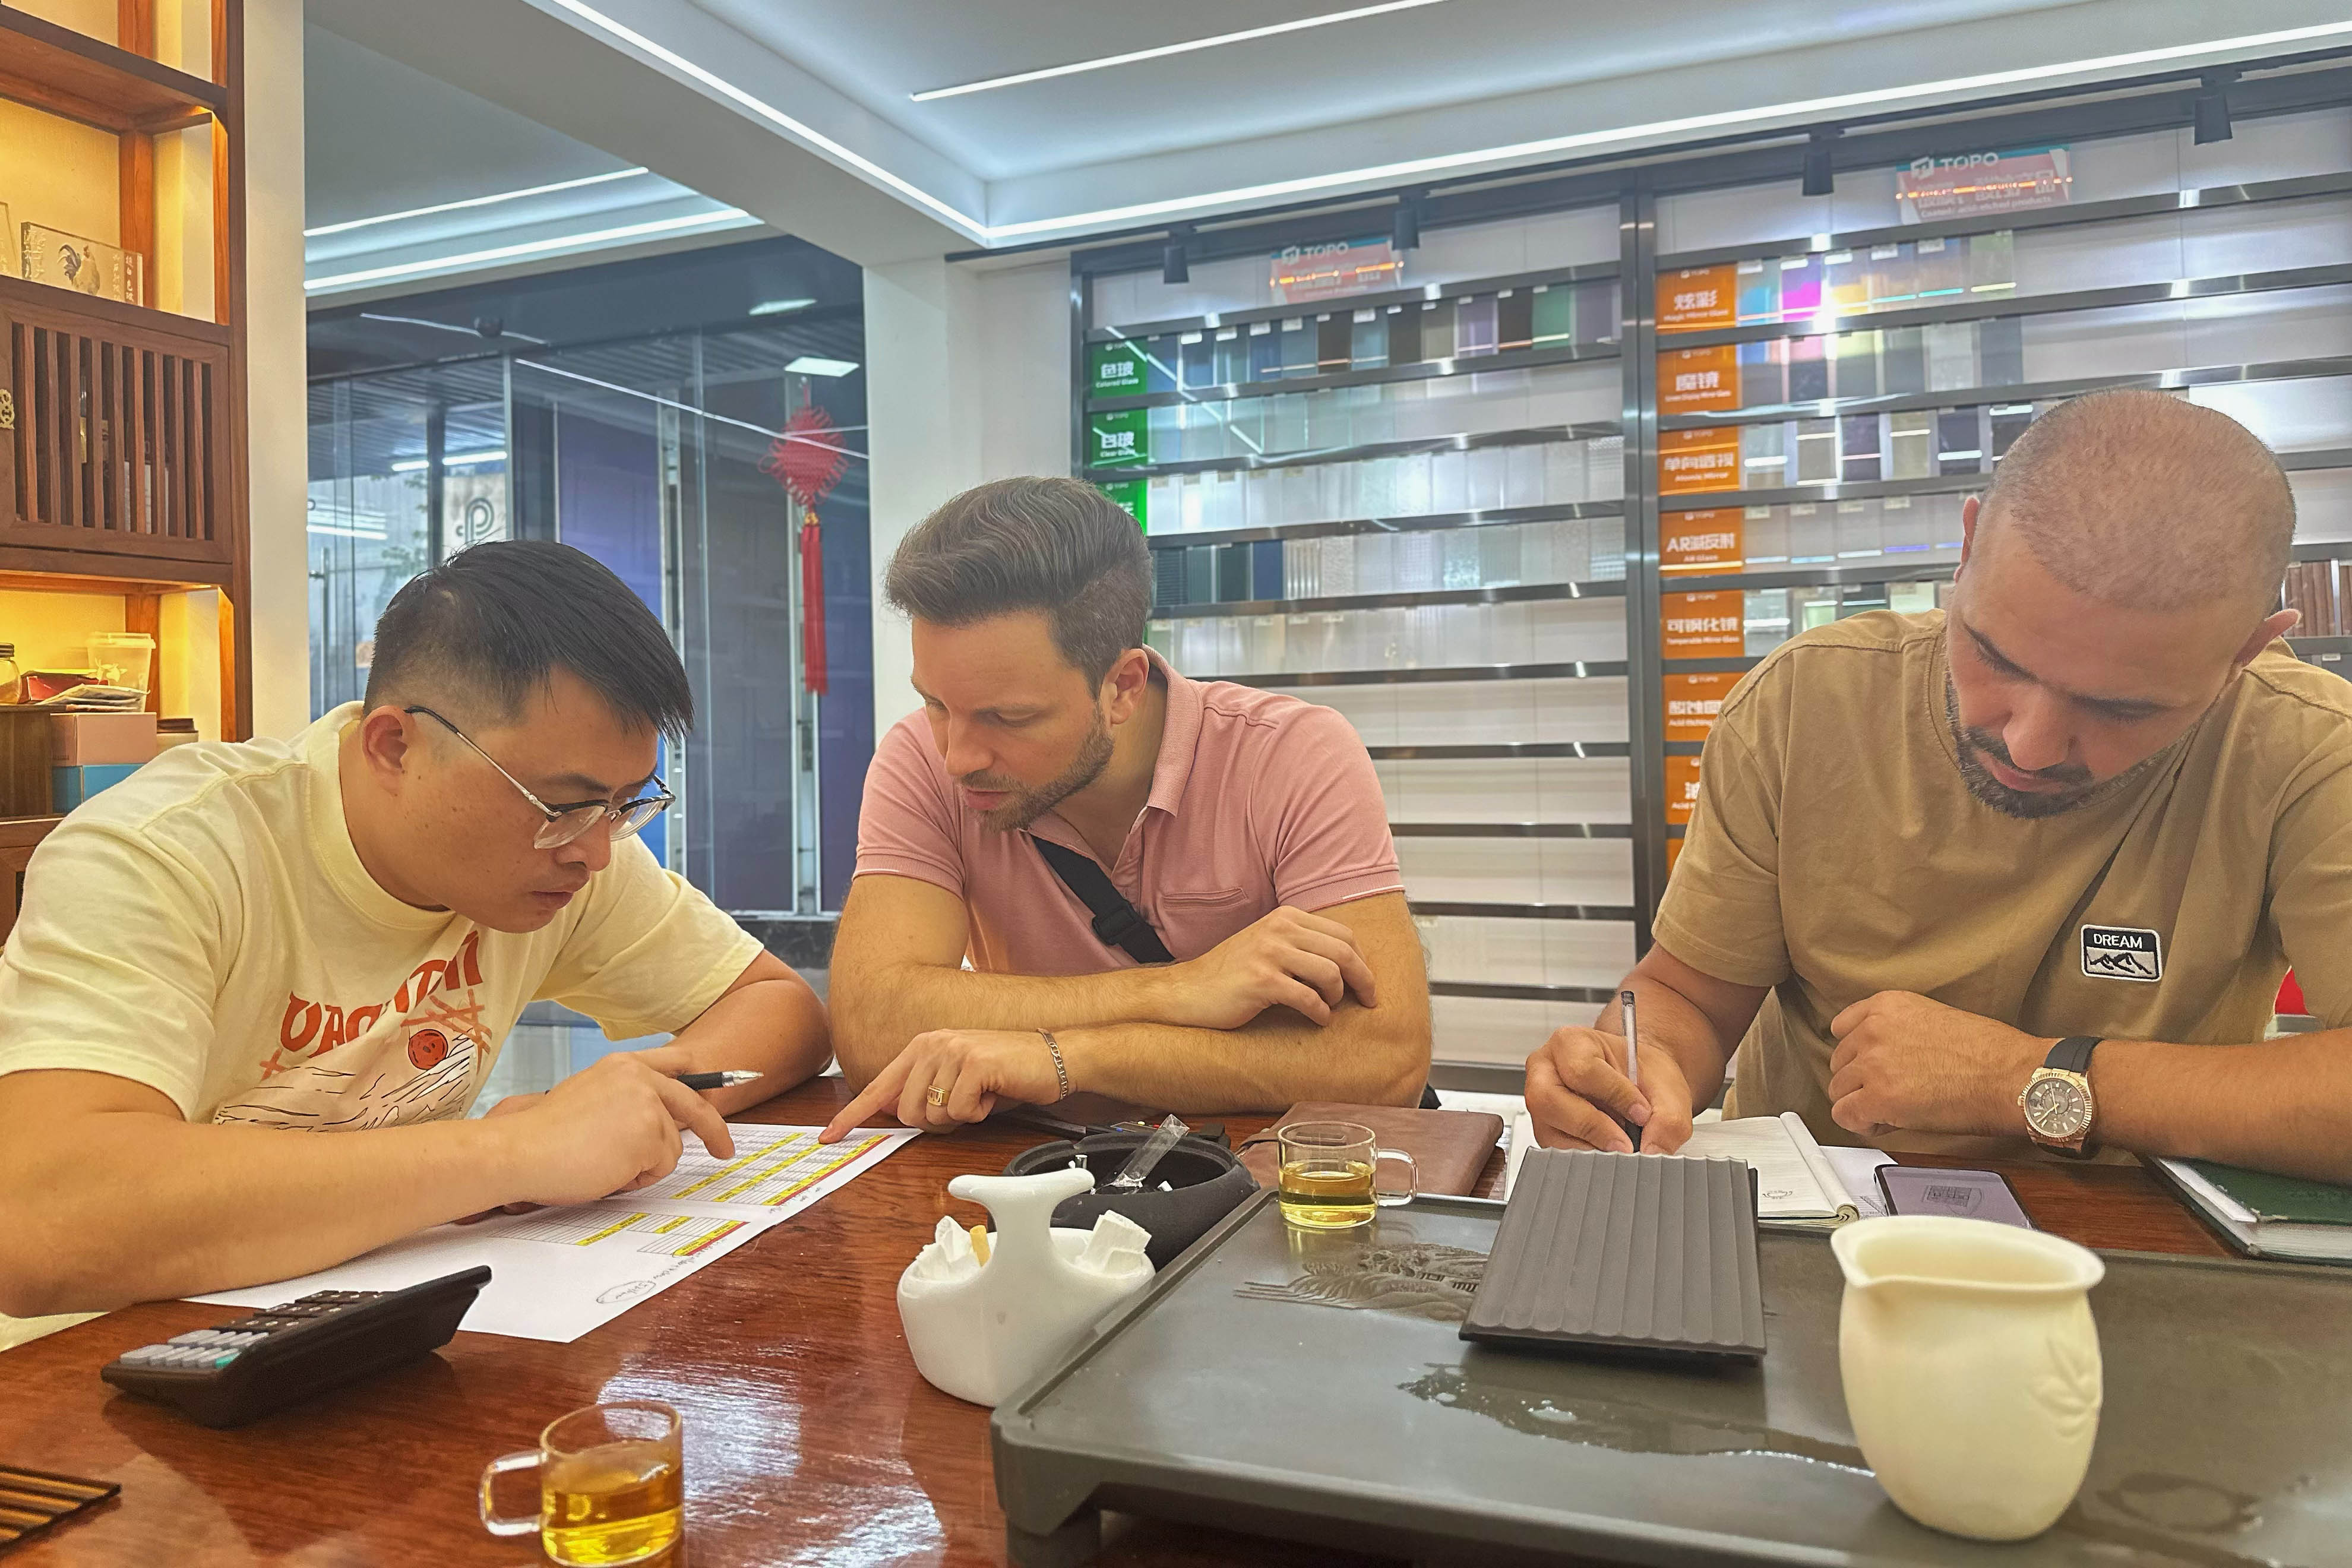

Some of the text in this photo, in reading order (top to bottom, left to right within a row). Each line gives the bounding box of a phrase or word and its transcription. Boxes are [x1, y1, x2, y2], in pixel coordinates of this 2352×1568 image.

[1940, 152, 1999, 172] TOPO
[1305, 242, 1348, 260] TOPO
[1101, 361, 1134, 379] 色玻
[2094, 934, 2143, 949] DREAM
